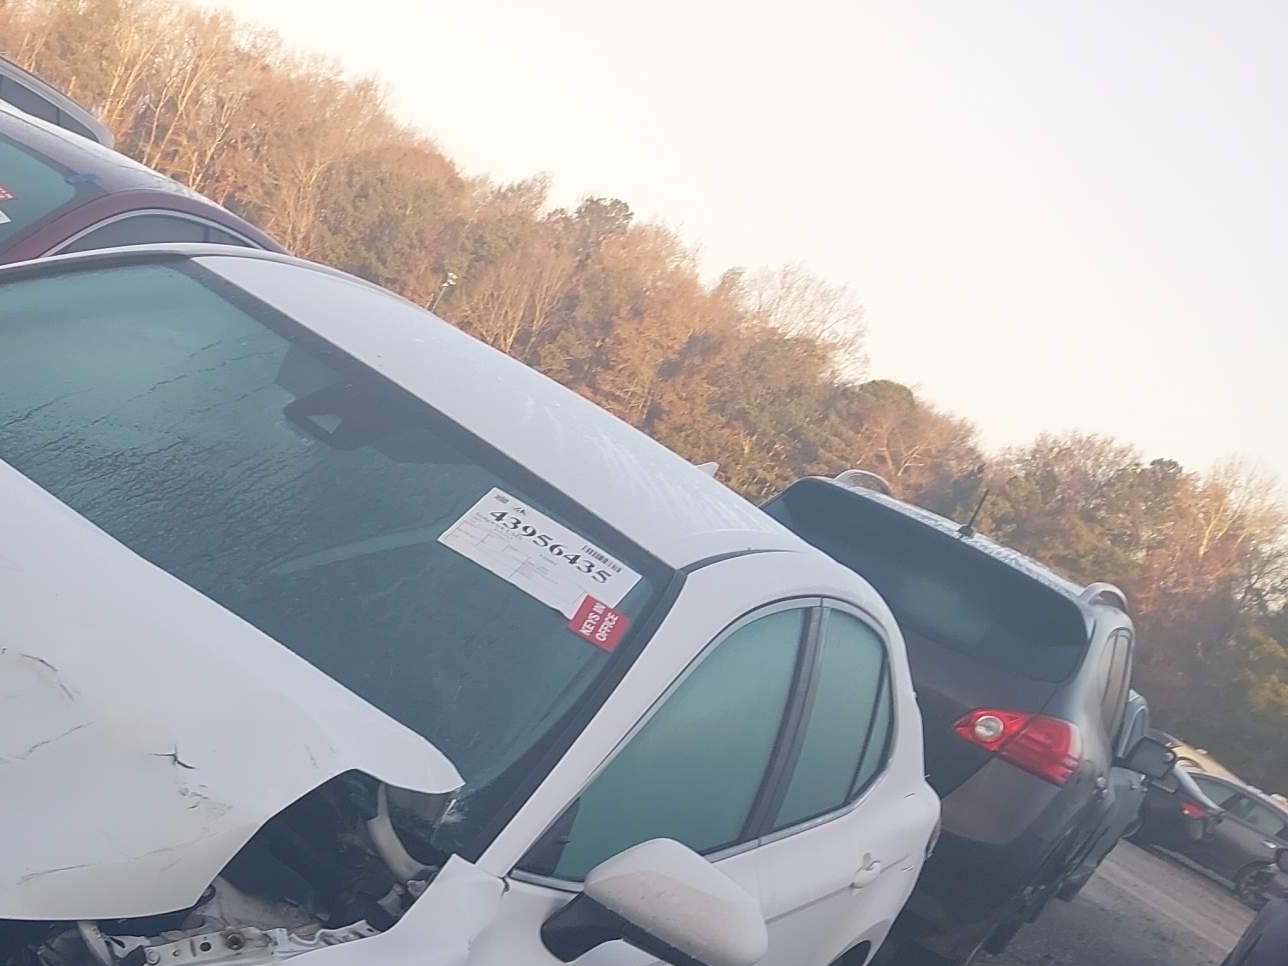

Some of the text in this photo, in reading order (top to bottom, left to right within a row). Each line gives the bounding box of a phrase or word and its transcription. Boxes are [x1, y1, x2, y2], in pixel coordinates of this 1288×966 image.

[489, 510, 613, 585] 43956435
[579, 612, 601, 637] KEYS
[595, 611, 619, 642] OFFICE
